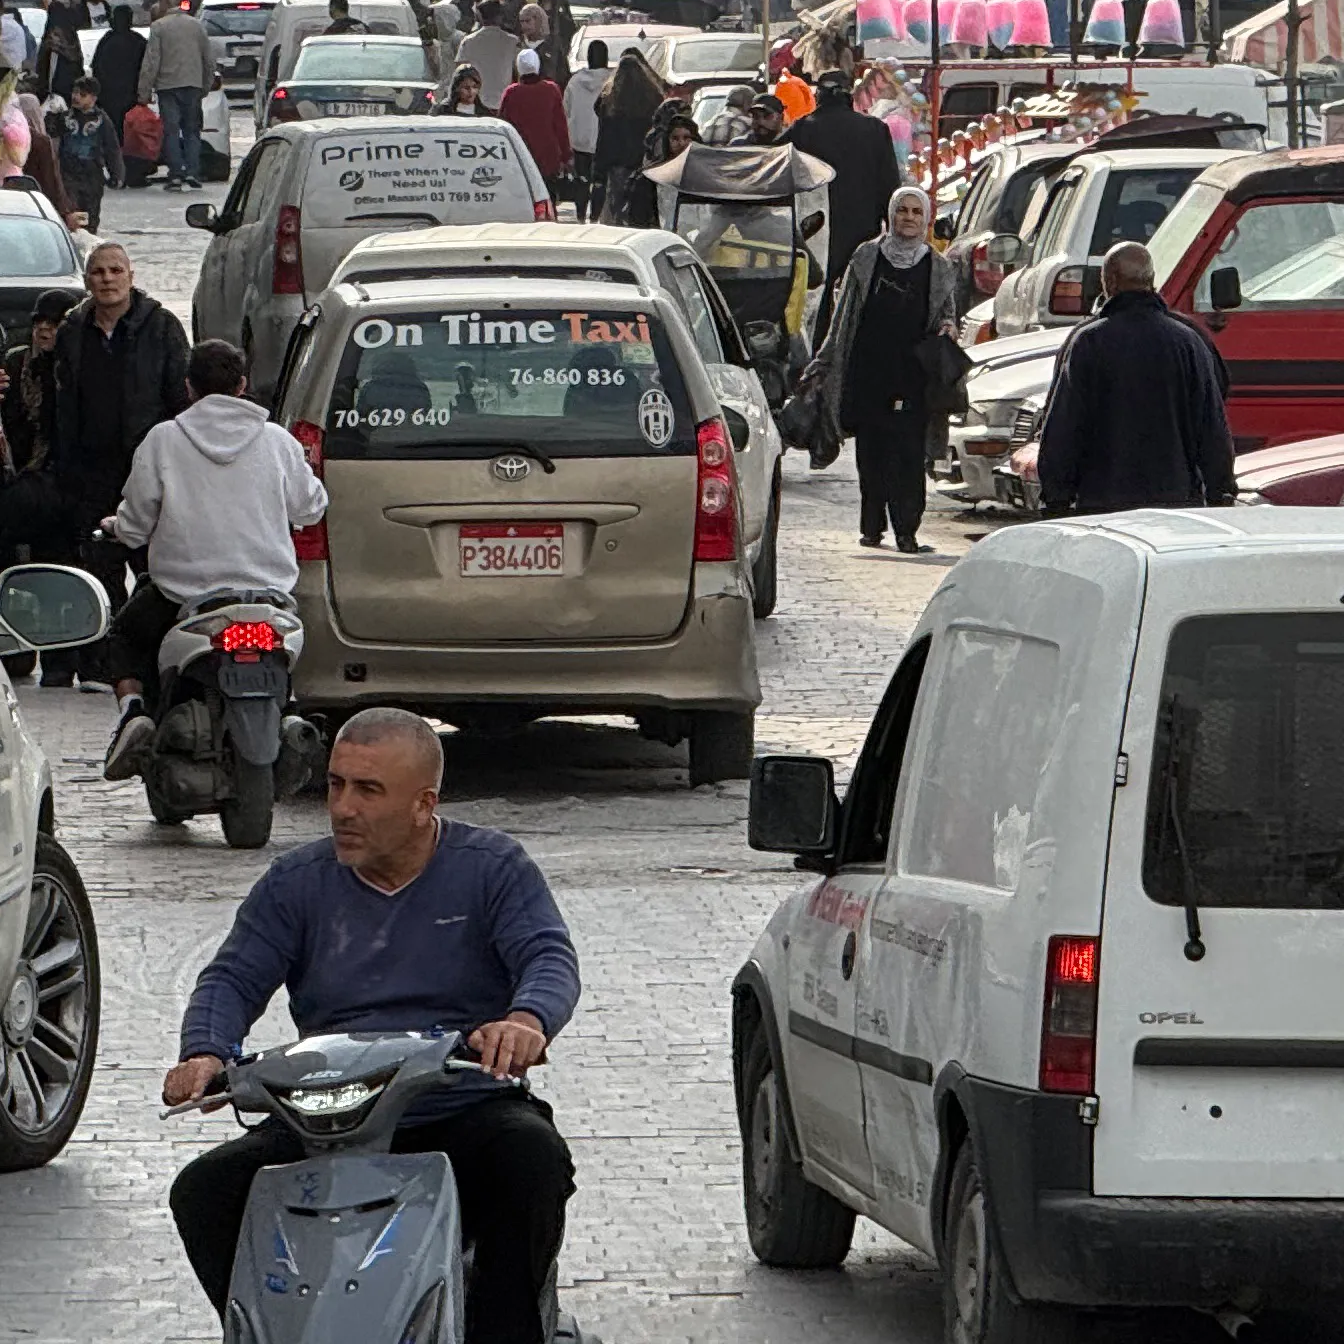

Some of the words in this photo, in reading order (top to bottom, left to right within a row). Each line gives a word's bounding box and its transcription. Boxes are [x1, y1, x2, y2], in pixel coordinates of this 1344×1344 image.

[321, 141, 424, 165] Prime
[434, 139, 508, 160] Taxi
[367, 169, 402, 179] There
[404, 167, 439, 177] When
[442, 167, 466, 176] You
[392, 179, 426, 188] Need
[429, 179, 447, 188] Us!
[430, 192, 446, 203] 03
[449, 192, 471, 203] 769
[474, 192, 497, 203] 557
[353, 318, 424, 349] On
[440, 312, 556, 346] Time
[561, 312, 653, 345] Taxi
[509, 367, 582, 387] 76-860
[586, 367, 626, 387] 836
[334, 409, 406, 429] 70-629
[411, 406, 452, 427] 640
[462, 544, 562, 571] P384406
[1139, 1011, 1205, 1025] OPEL
